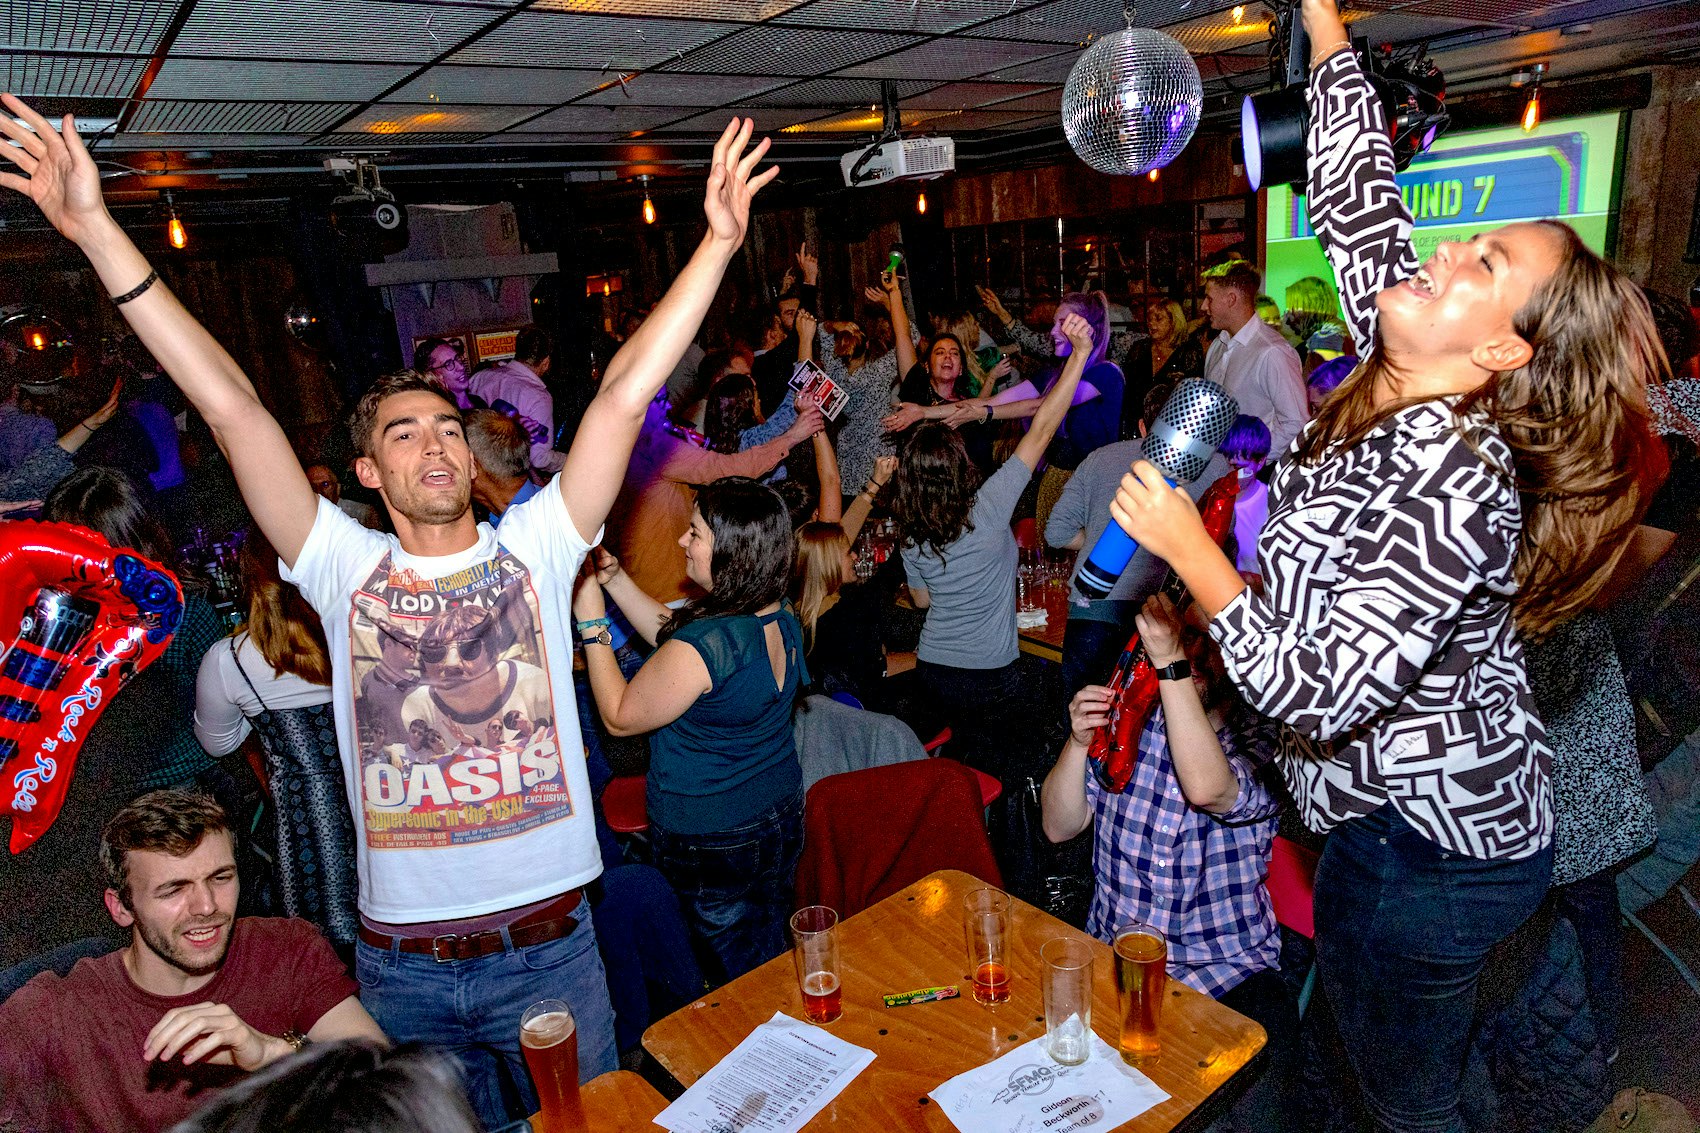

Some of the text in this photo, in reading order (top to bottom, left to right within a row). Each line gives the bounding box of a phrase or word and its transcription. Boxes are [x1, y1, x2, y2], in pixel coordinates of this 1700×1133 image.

[1473, 175, 1496, 216] 7
[437, 563, 486, 593] ECHOBELLY
[455, 588, 469, 596] IN
[58, 685, 102, 742] Rock
[12, 752, 57, 812] Roll
[365, 740, 560, 807] OASIS
[525, 793, 568, 804] EXCLUSIVE
[533, 784, 560, 793] 4-PAGE
[368, 794, 524, 832] Supersonic in the USA!
[433, 832, 447, 840] ADS
[1008, 1066, 1052, 1093] SFMQ
[1040, 1096, 1074, 1114] Gideon
[1043, 1100, 1090, 1128] Beckworth
[1055, 1112, 1097, 1133] Team of 8
